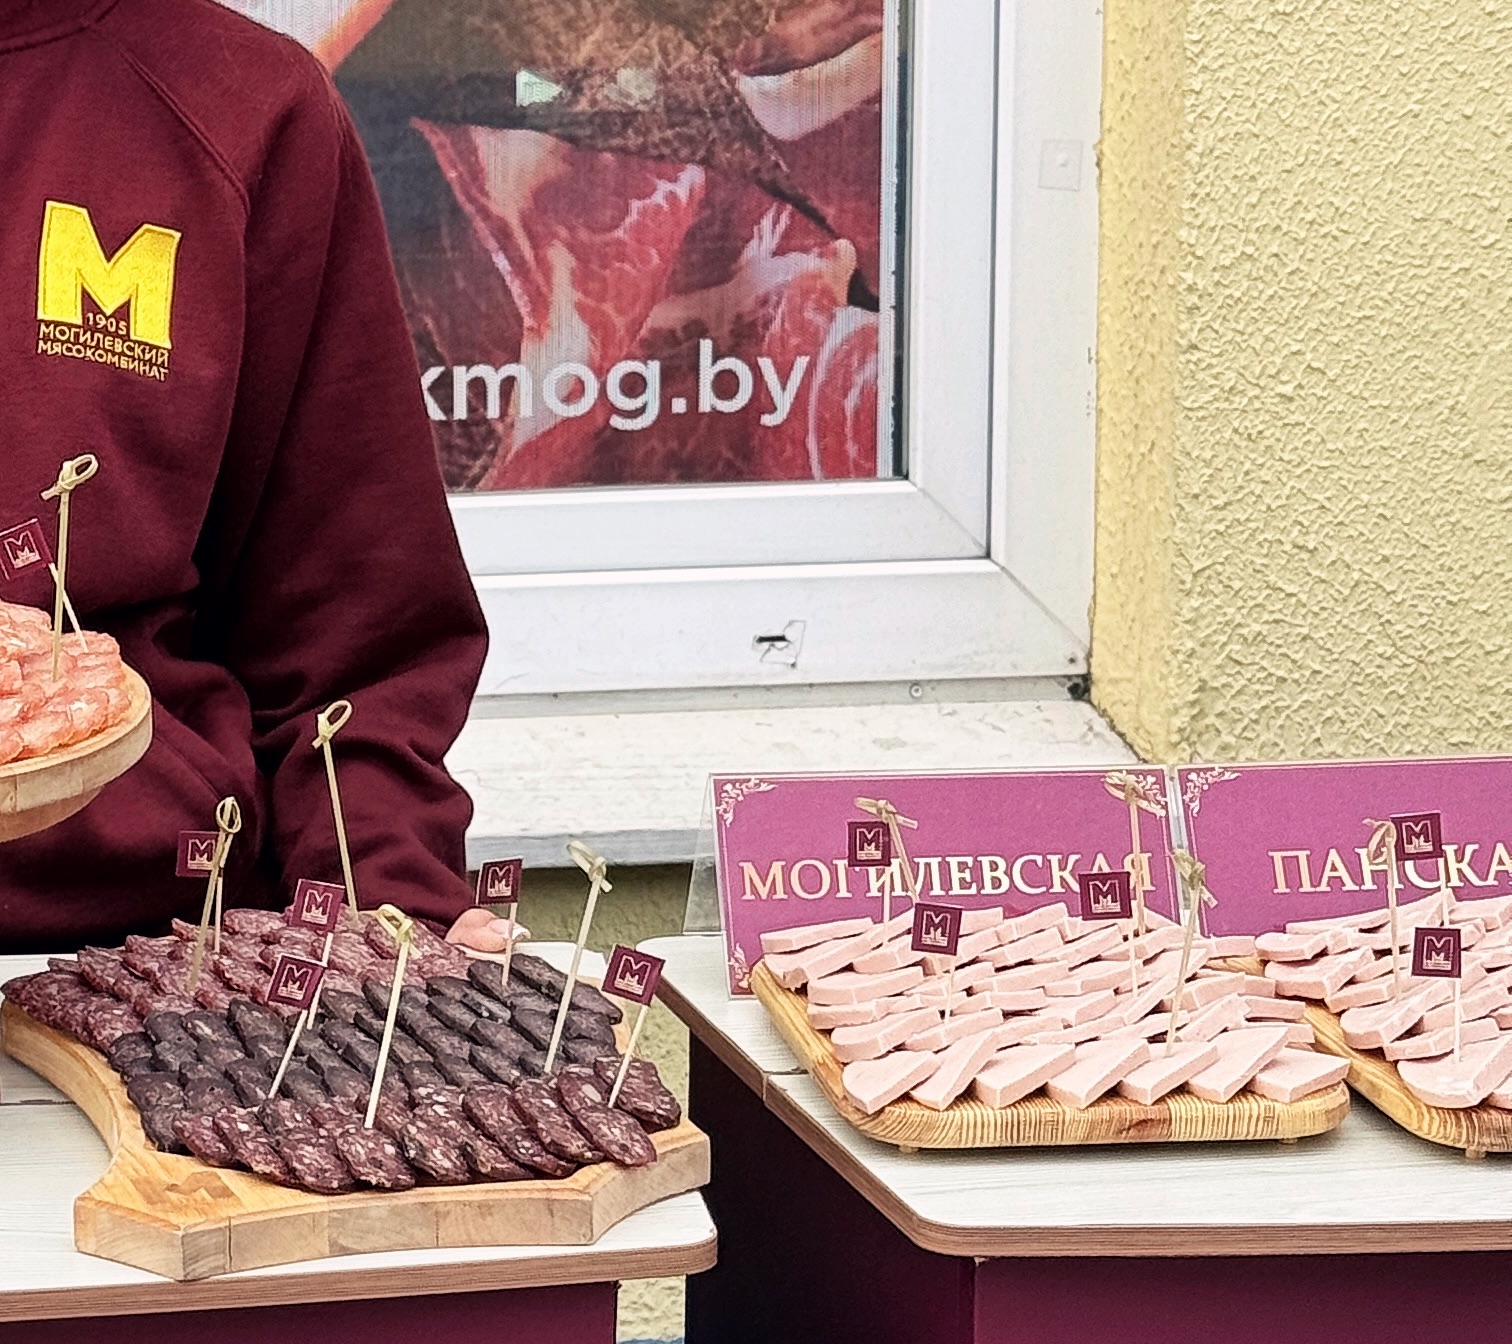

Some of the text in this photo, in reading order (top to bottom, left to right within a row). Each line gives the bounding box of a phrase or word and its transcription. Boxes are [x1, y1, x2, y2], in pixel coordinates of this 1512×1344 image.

[37, 200, 182, 350] М
[38, 322, 170, 368] МОГИЛЕВСКИЙ
[86, 311, 128, 336] 1905
[37, 339, 170, 383] МЯСОКОМБИНАТ
